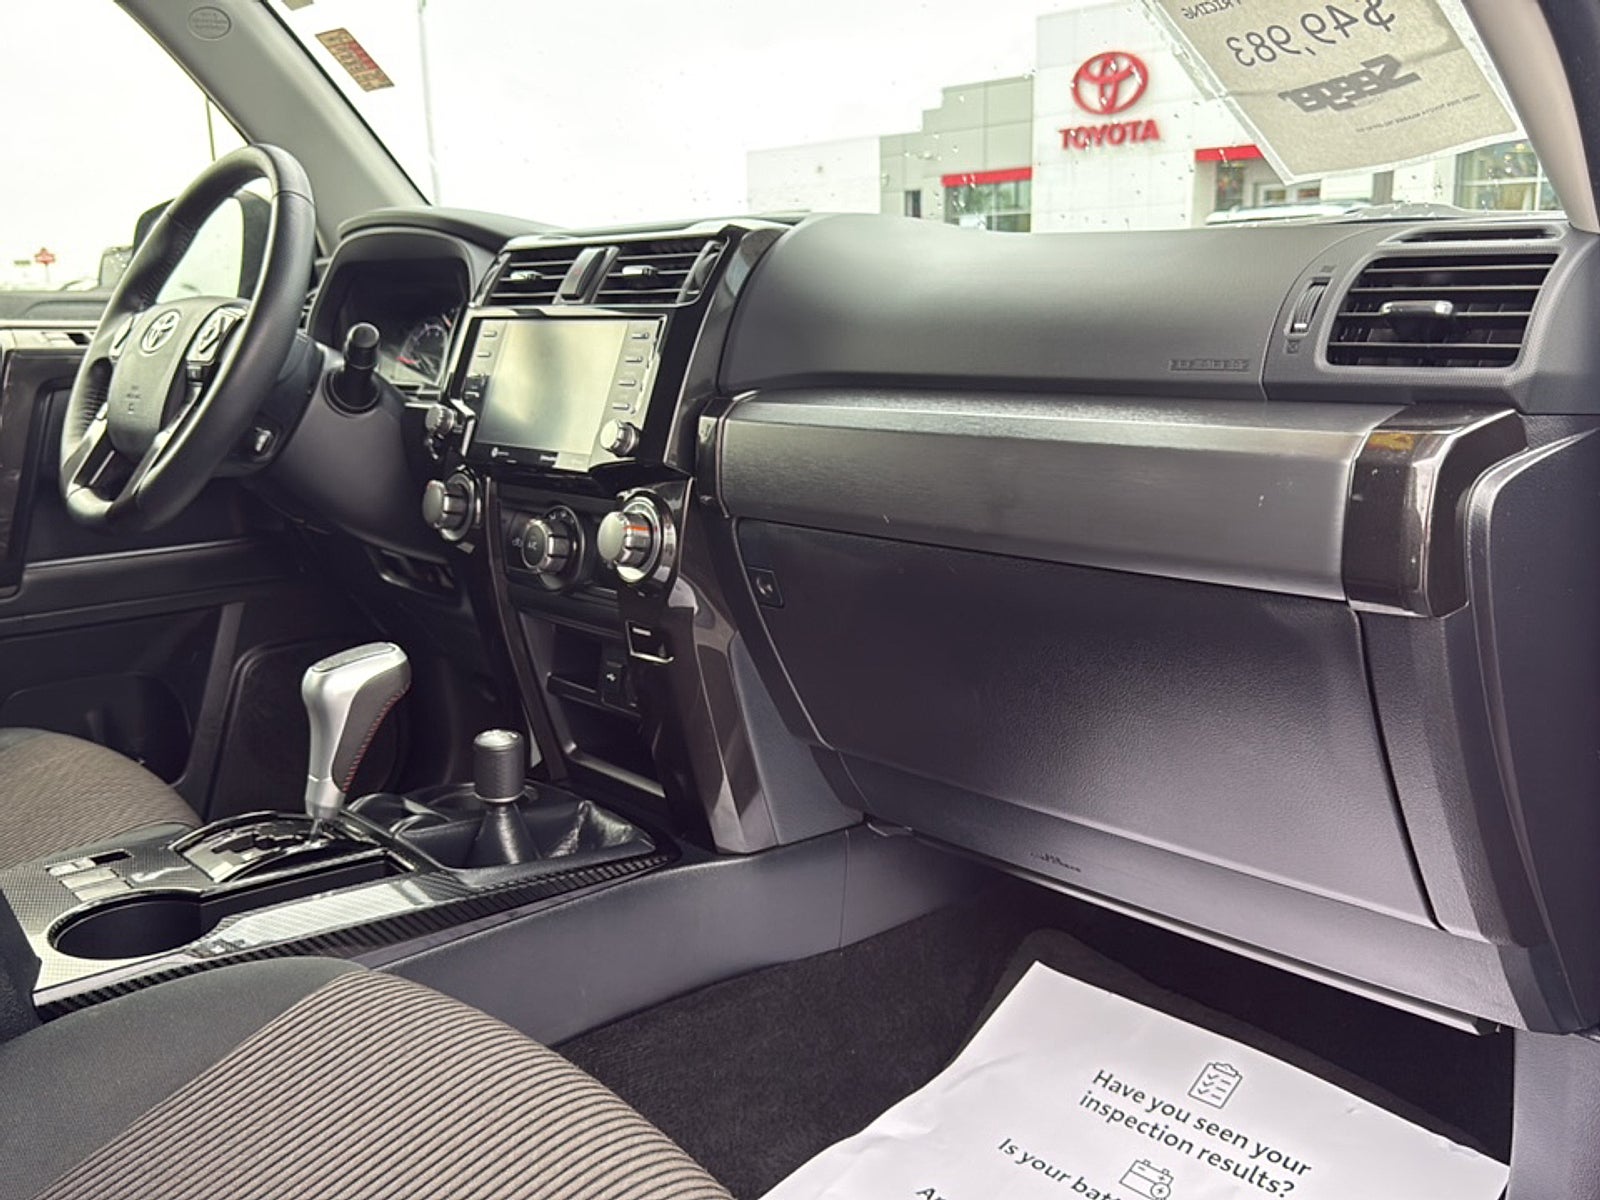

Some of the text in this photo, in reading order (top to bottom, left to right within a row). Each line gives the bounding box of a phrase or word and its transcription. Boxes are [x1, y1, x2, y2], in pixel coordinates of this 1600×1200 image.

[1058, 119, 1161, 150] TOYOTA
[998, 1138, 1019, 1156] Is
[1015, 1151, 1071, 1183] your
[1079, 1090, 1295, 1198] inspection results?
[1092, 1069, 1312, 1177] Have you seen your
